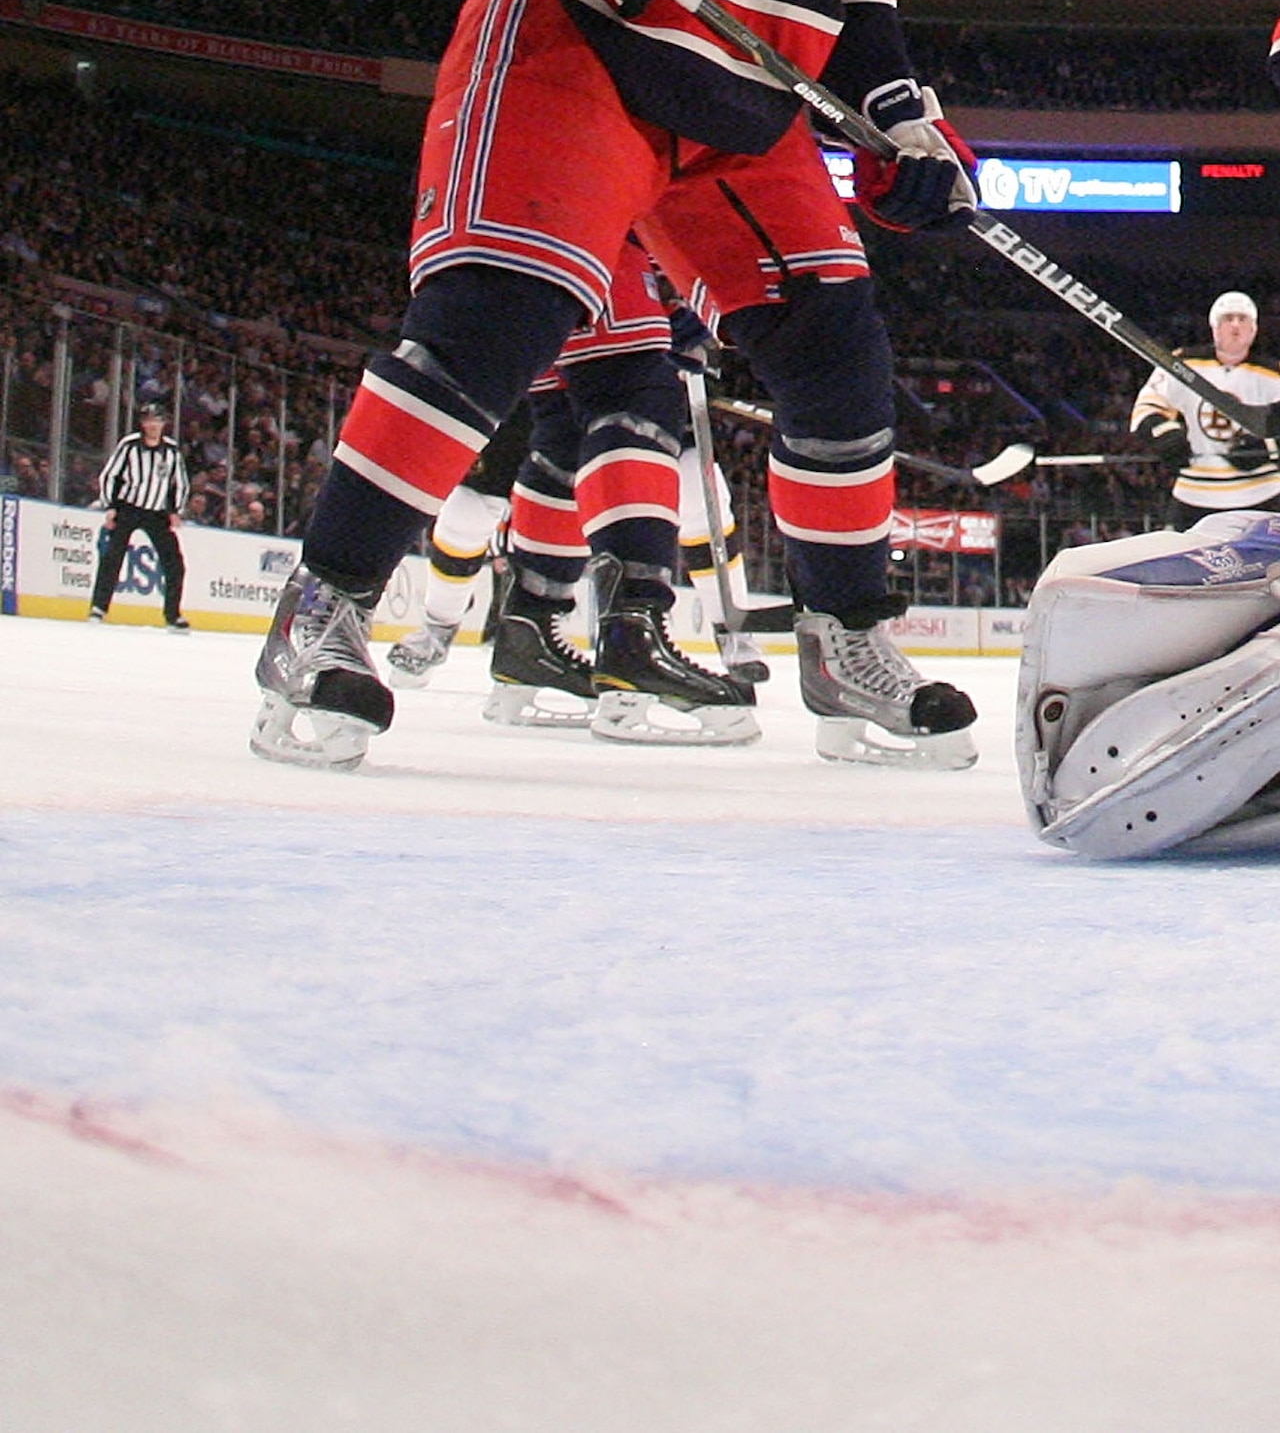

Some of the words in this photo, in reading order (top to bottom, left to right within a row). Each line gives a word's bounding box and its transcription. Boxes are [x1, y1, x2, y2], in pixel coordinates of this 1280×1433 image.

[793, 81, 845, 124] BAUER
[1018, 167, 1071, 203] TV
[985, 221, 1123, 332] BAUER
[2, 499, 16, 591] Reebok
[52, 519, 92, 543] where
[52, 545, 92, 566] music
[62, 566, 91, 588] lives
